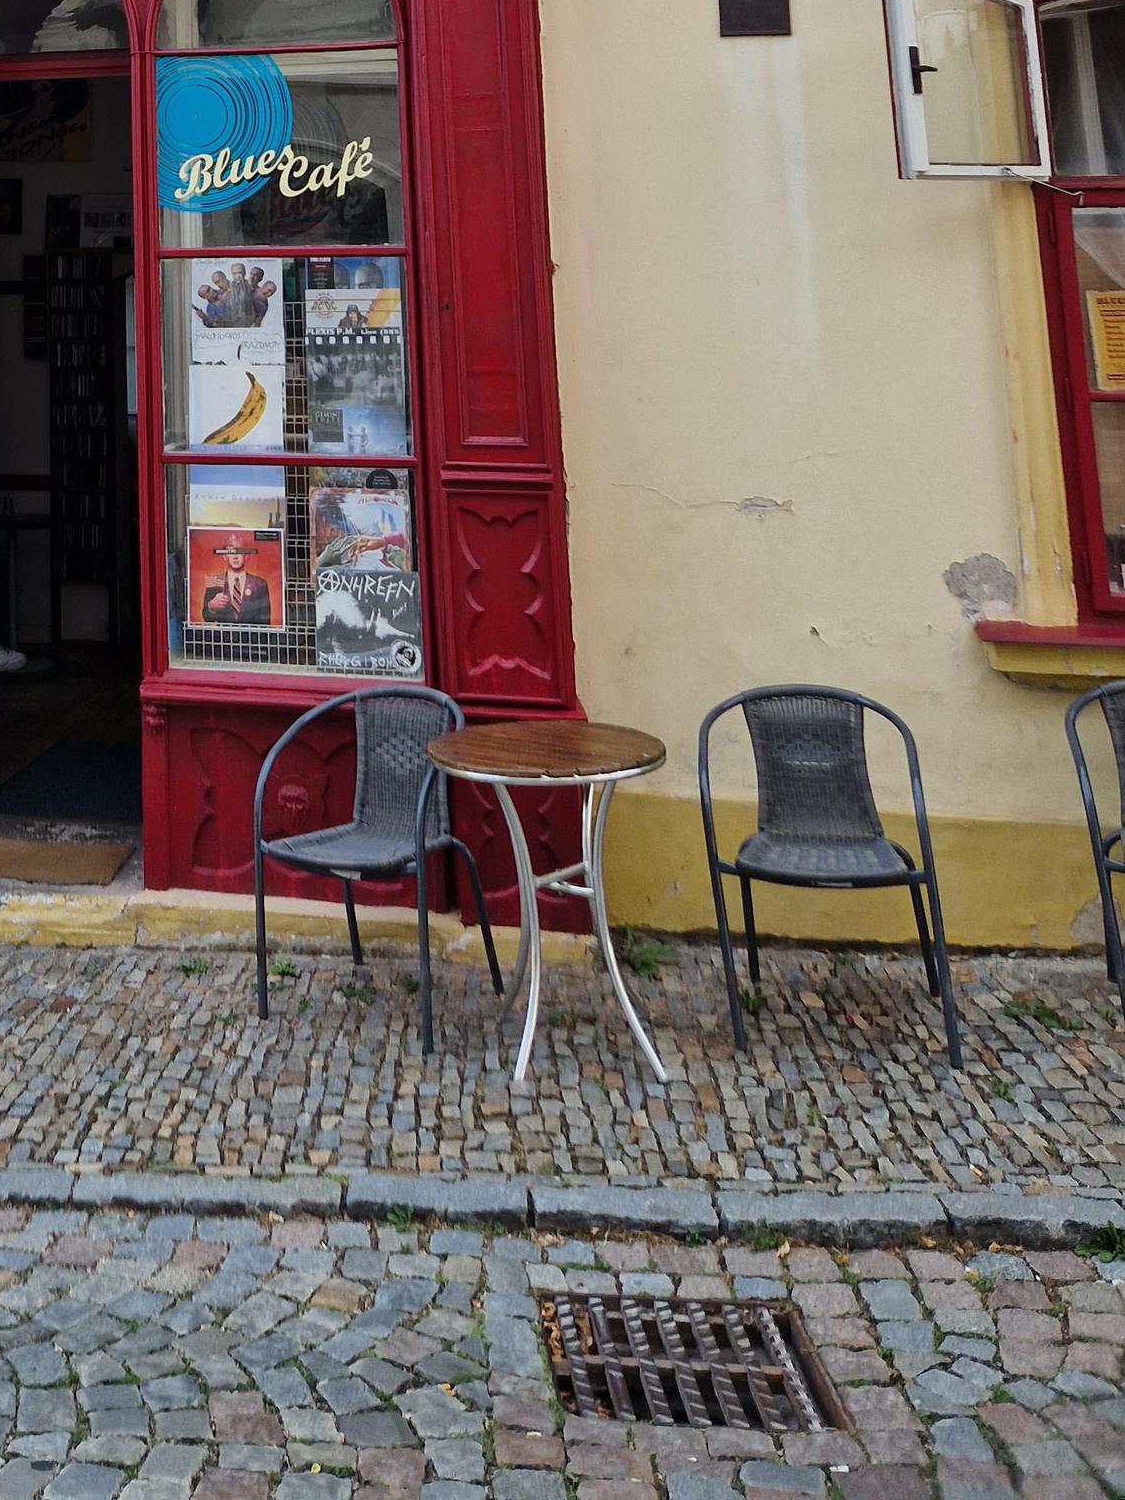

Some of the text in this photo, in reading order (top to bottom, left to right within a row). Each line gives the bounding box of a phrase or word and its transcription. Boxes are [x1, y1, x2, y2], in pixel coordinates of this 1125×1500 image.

[174, 135, 374, 203] Blues Café
[306, 327, 335, 336] PLEXIS
